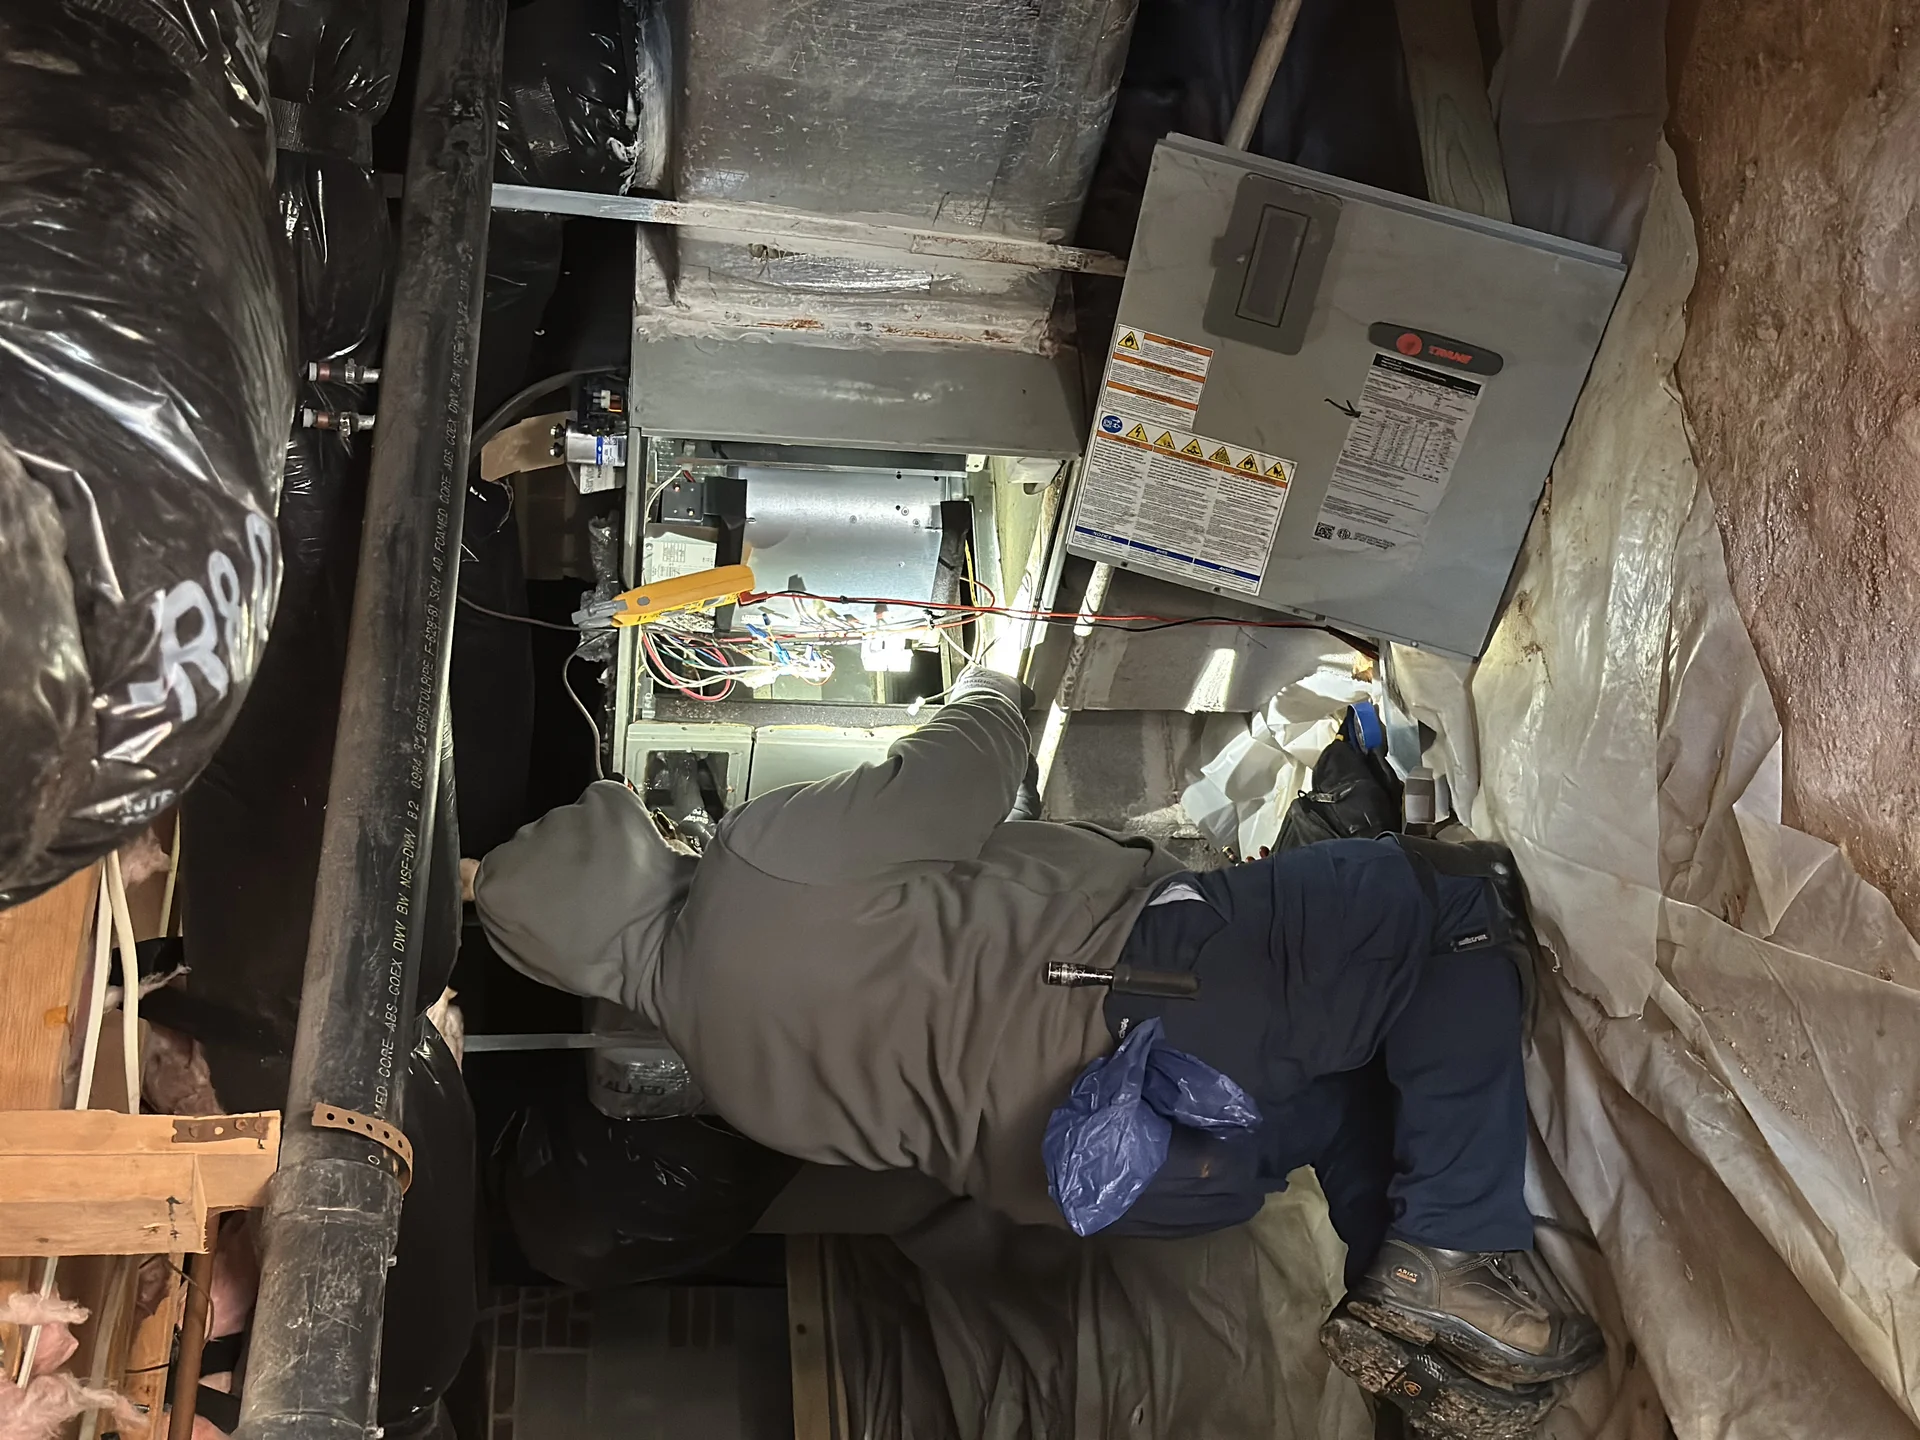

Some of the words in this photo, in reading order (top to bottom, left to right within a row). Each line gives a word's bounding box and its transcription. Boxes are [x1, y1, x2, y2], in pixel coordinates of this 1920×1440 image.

[434, 507, 449, 553] FOAMED
[432, 556, 445, 573] 40
[429, 575, 442, 601] SCH
[416, 659, 434, 734] BRISTOLPIPE
[399, 827, 417, 889] NSF-DWV
[396, 892, 410, 916] BW
[392, 919, 407, 953] DWV
[384, 1002, 398, 1034] ABS
[379, 1038, 395, 1079] CORE
[1397, 1268, 1418, 1278] ARIAT
